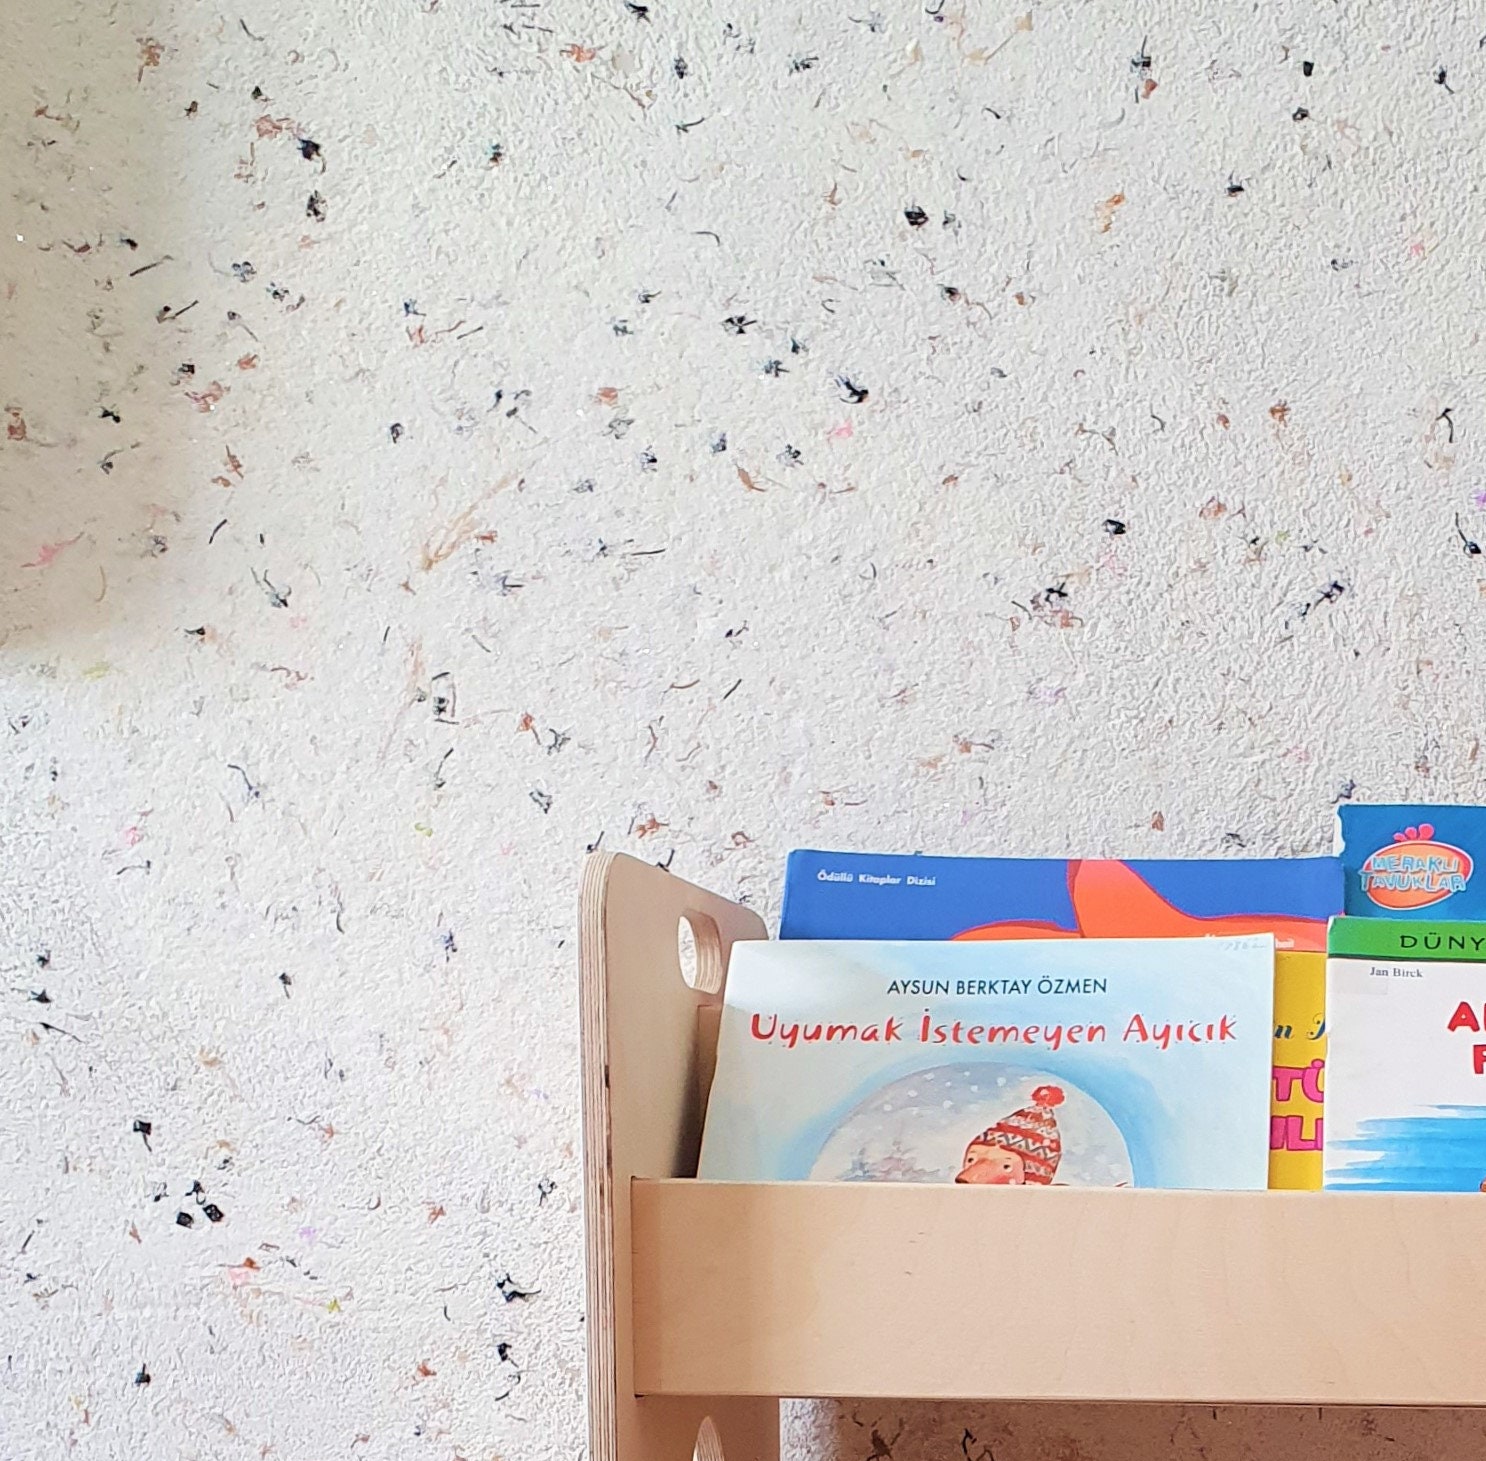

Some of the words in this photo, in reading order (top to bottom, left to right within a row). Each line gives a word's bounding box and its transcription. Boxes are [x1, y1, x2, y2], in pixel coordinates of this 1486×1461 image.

[1370, 854, 1460, 873] MERAKLI
[817, 868, 854, 883] Ödüllü
[858, 873, 901, 886] Kitaplar
[906, 875, 936, 886] Dizisi
[1357, 869, 1467, 893] TAVUKLAR
[1370, 967, 1389, 977] Jan
[1393, 967, 1424, 979] Birck
[887, 979, 949, 995] AYSUN
[956, 979, 1032, 995] BERKTAY
[1038, 975, 1108, 995] ÖZMEN
[751, 1012, 904, 1049] Uyumak
[920, 1007, 1107, 1051] İstemeyen
[1122, 1012, 1239, 1051] Ayıcık
